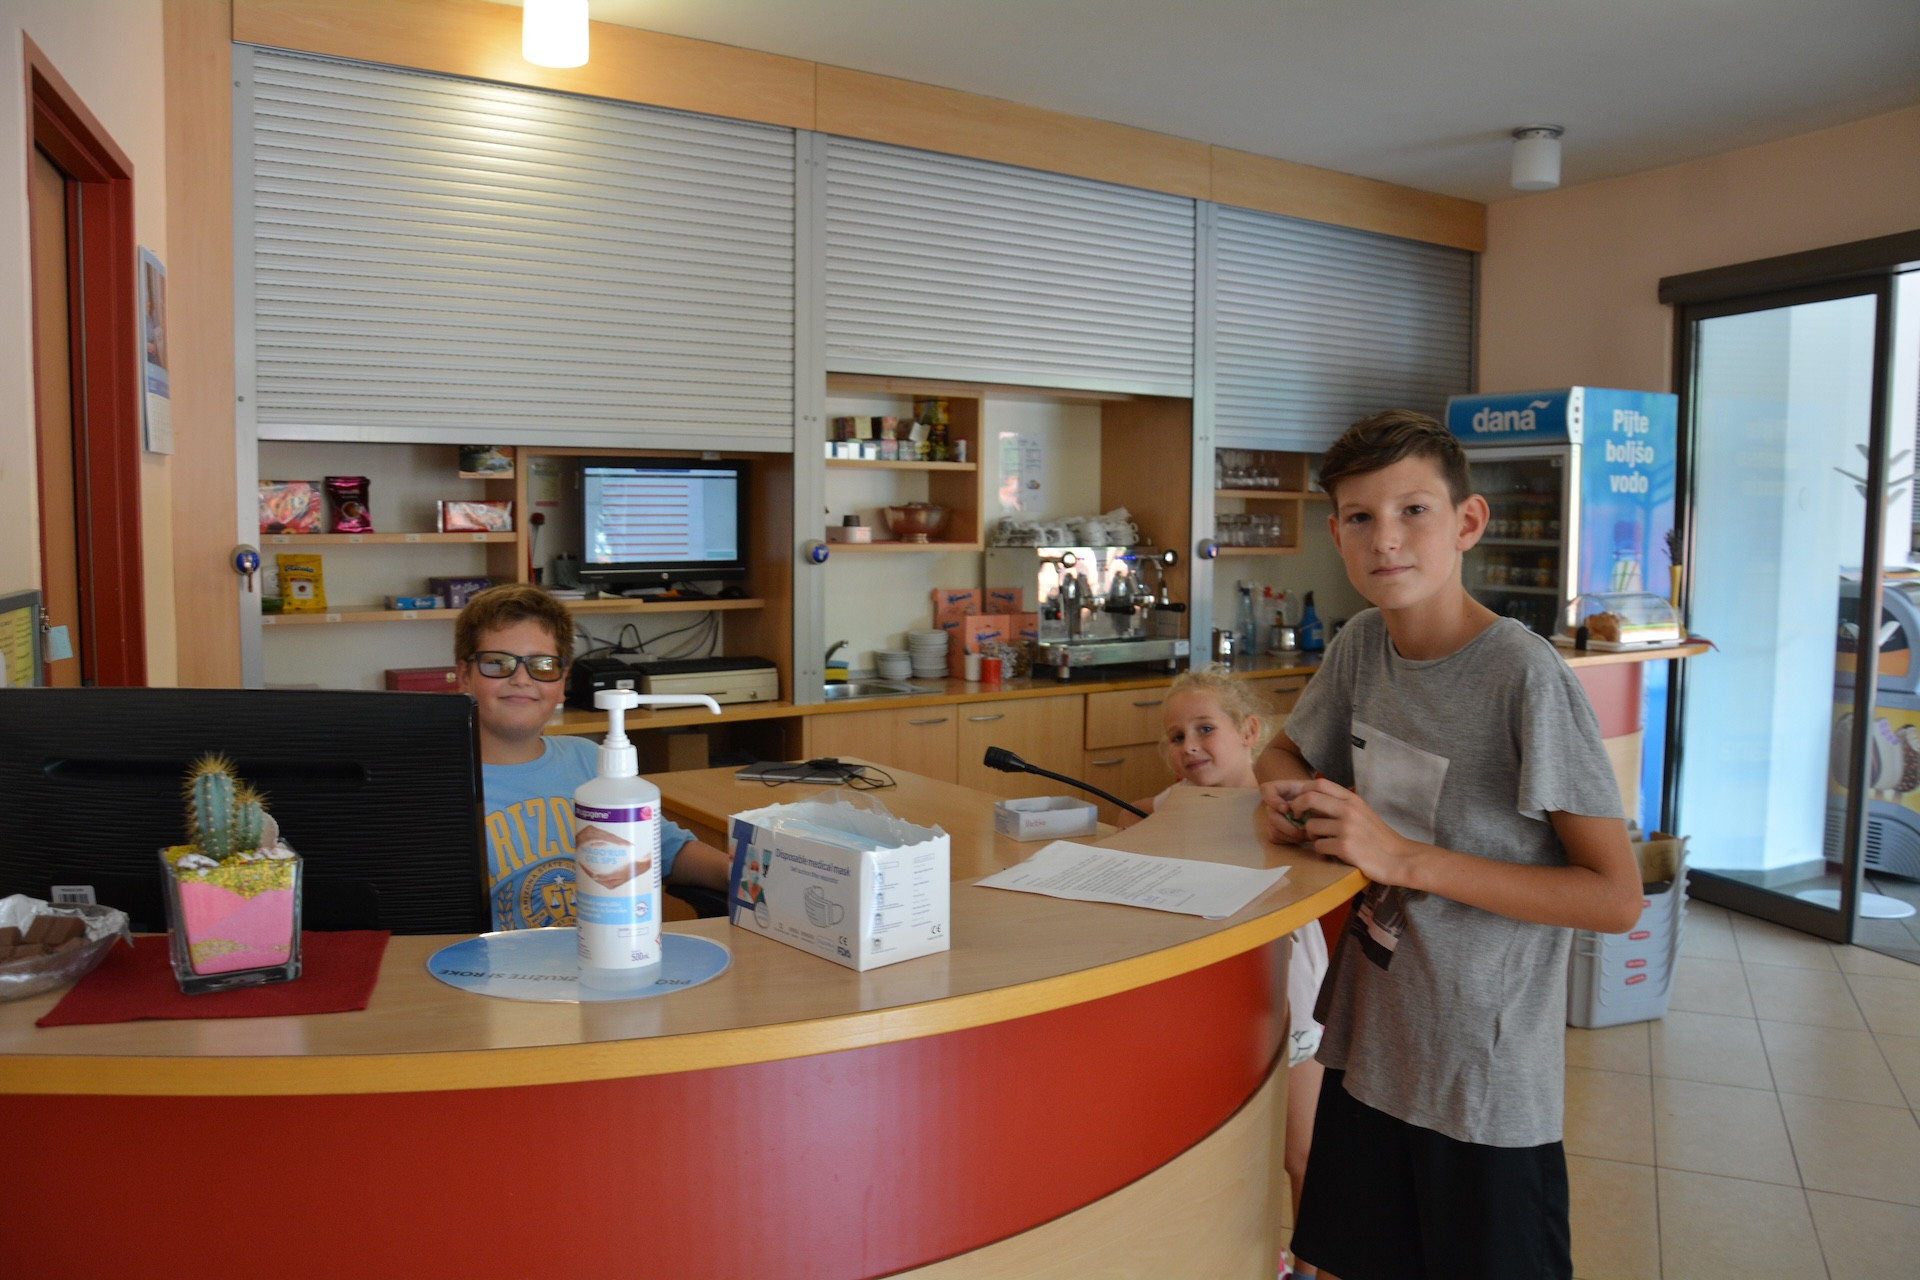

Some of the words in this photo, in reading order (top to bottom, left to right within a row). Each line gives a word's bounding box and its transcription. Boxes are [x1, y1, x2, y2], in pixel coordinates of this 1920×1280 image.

[1612, 409, 1649, 437] Pijte
[1605, 439, 1655, 468] boljšo
[1609, 471, 1649, 494] vodo
[485, 796, 577, 887] RIZO
[776, 848, 807, 866] Disposable
[808, 859, 833, 872] medical
[833, 865, 851, 876] mask
[438, 969, 486, 978] ROKE
